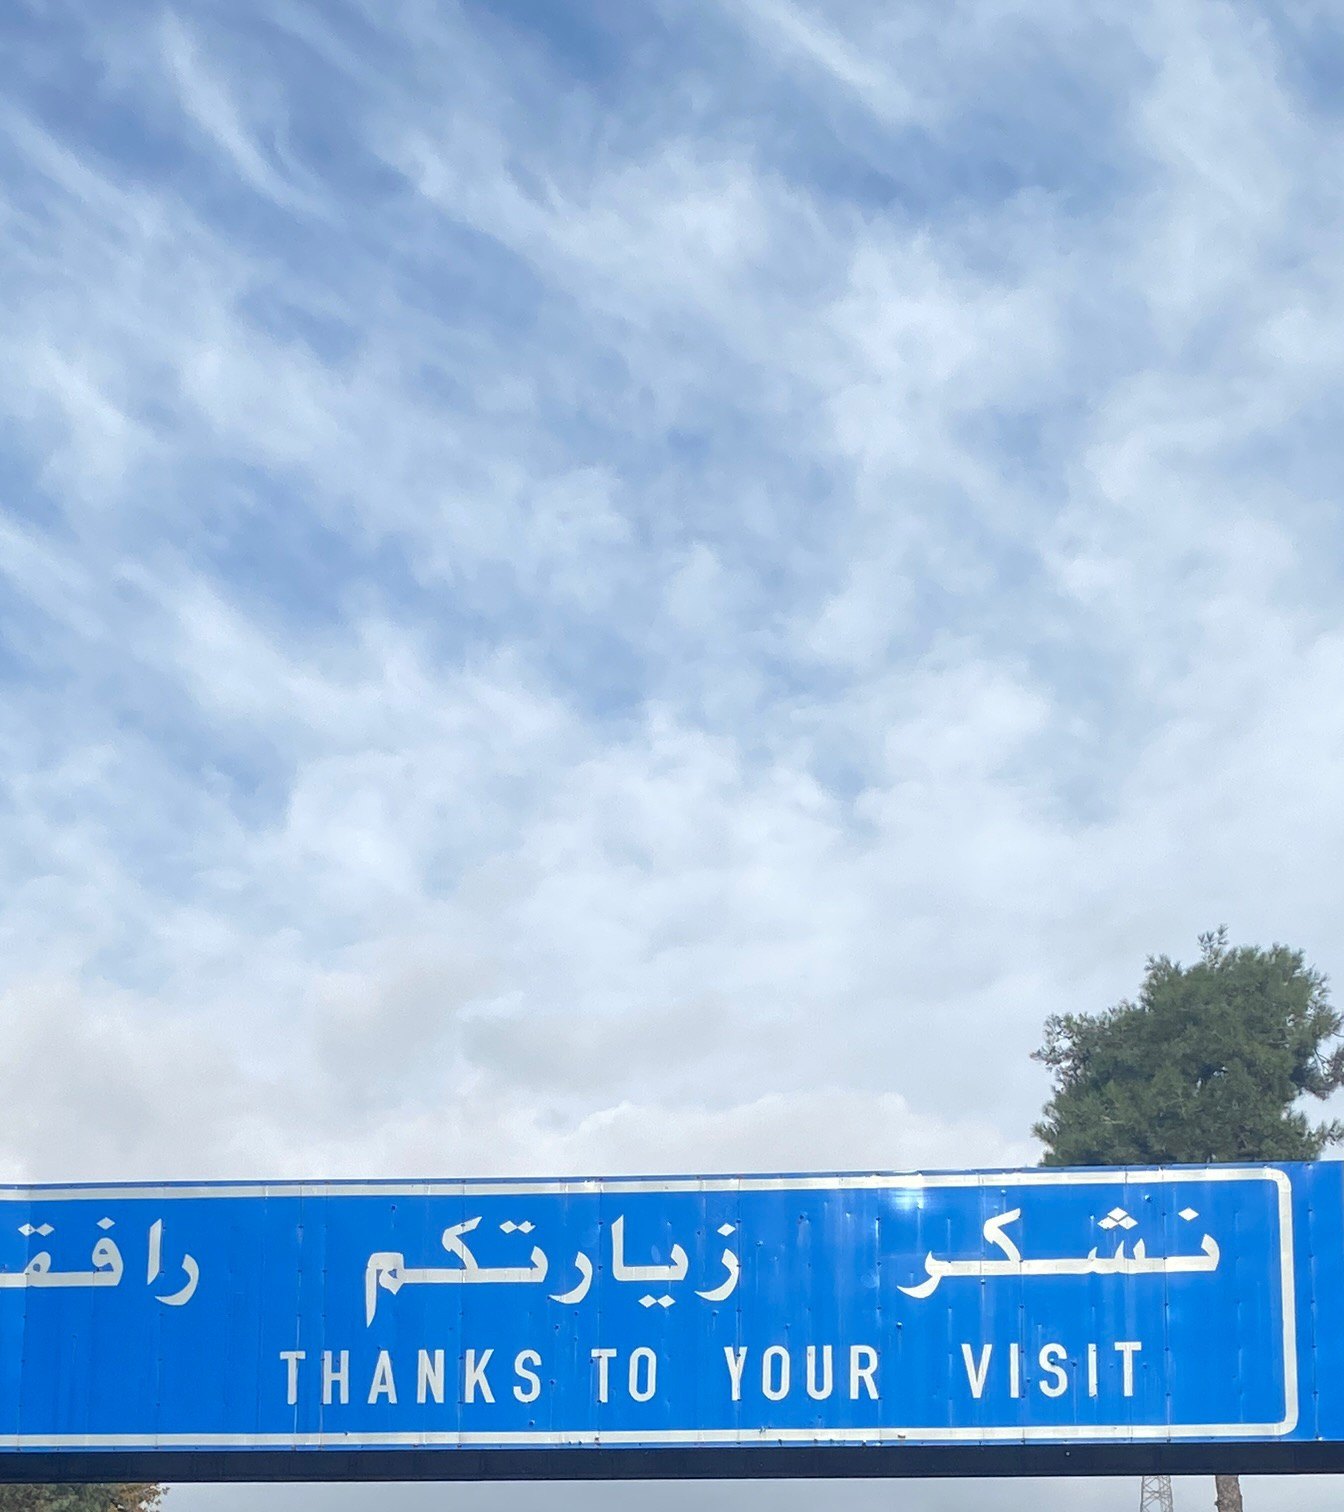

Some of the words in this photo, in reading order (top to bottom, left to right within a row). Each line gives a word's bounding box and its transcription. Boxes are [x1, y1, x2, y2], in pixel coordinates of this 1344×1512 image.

[364, 1214, 741, 1328] زيارتكم
[896, 1205, 1222, 1300] نشكر
[278, 1347, 543, 1406] THANKS
[589, 1345, 658, 1404] TO
[721, 1343, 881, 1402] YOUR
[959, 1339, 1144, 1400] VISIT
